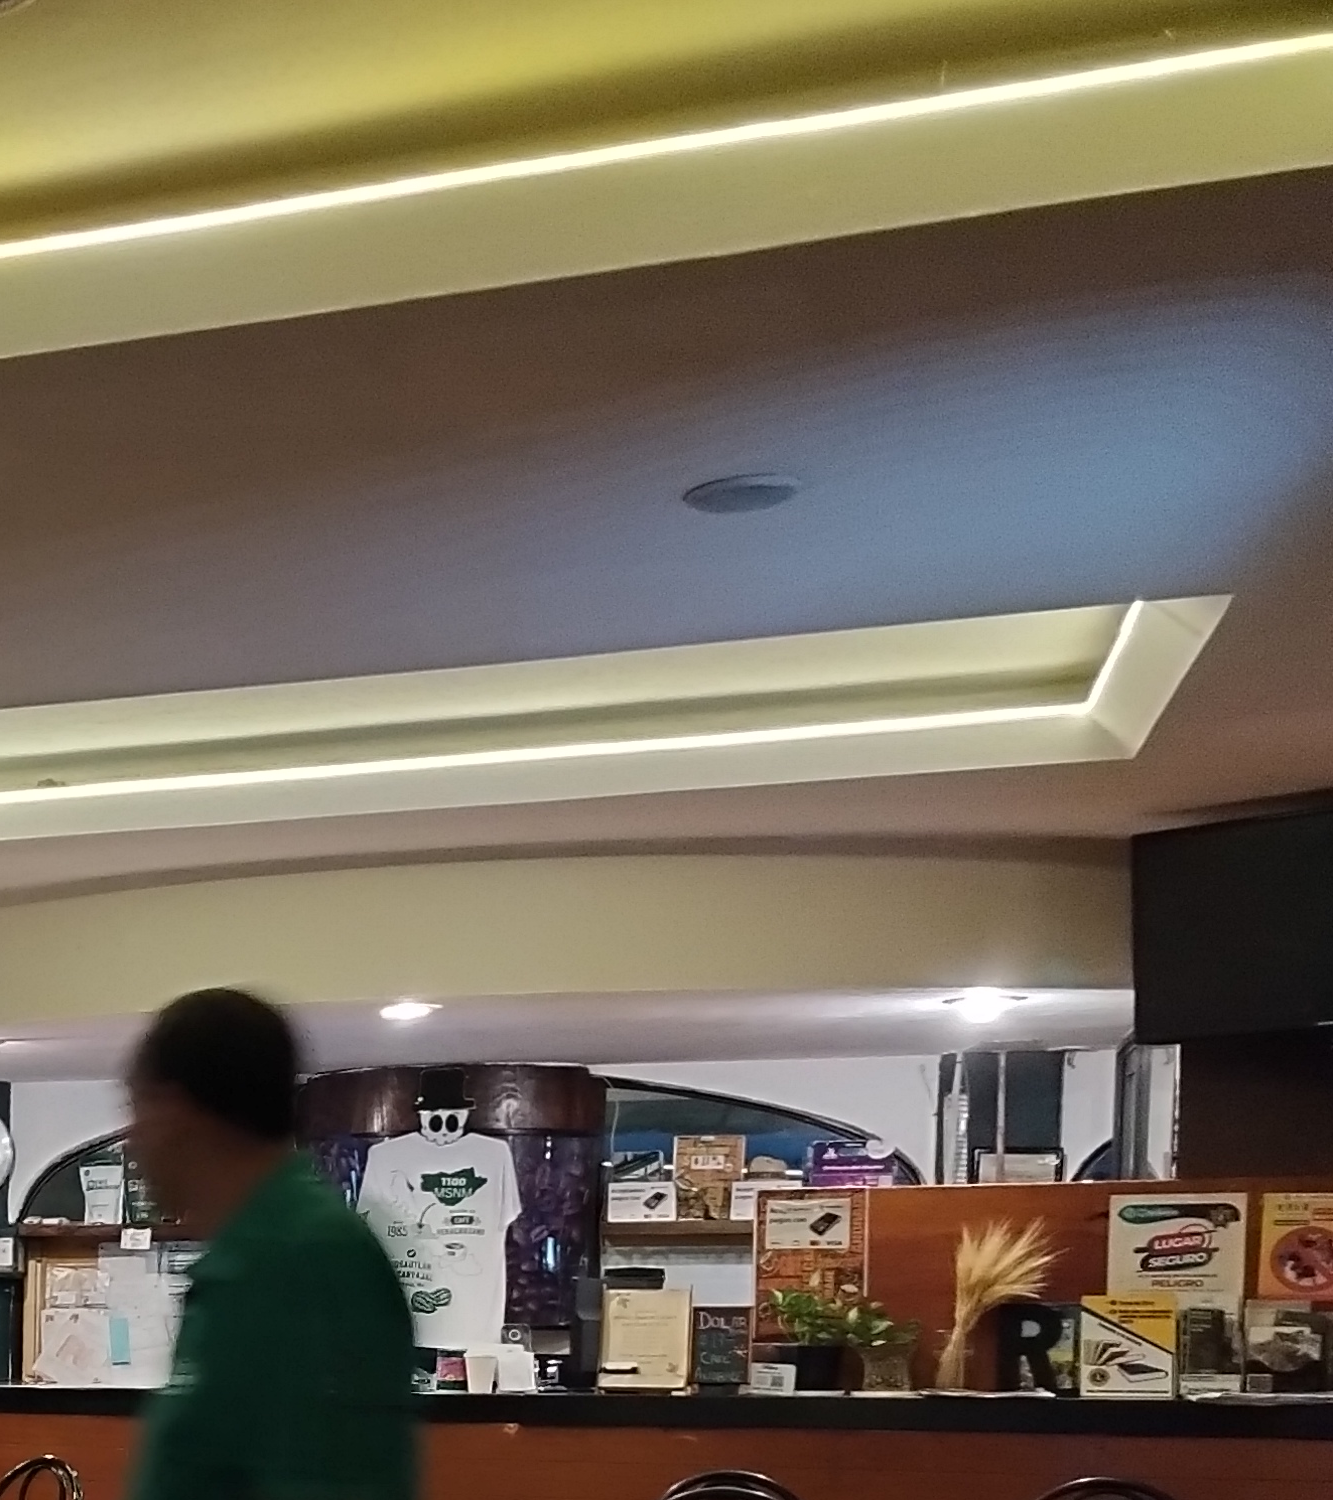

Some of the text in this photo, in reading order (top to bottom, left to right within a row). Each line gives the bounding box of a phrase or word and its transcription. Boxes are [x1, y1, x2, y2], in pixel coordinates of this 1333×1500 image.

[1154, 1234, 1203, 1250] LUGAR
[1148, 1252, 1207, 1268] SEGURO
[1151, 1279, 1204, 1288] PELIGRO
